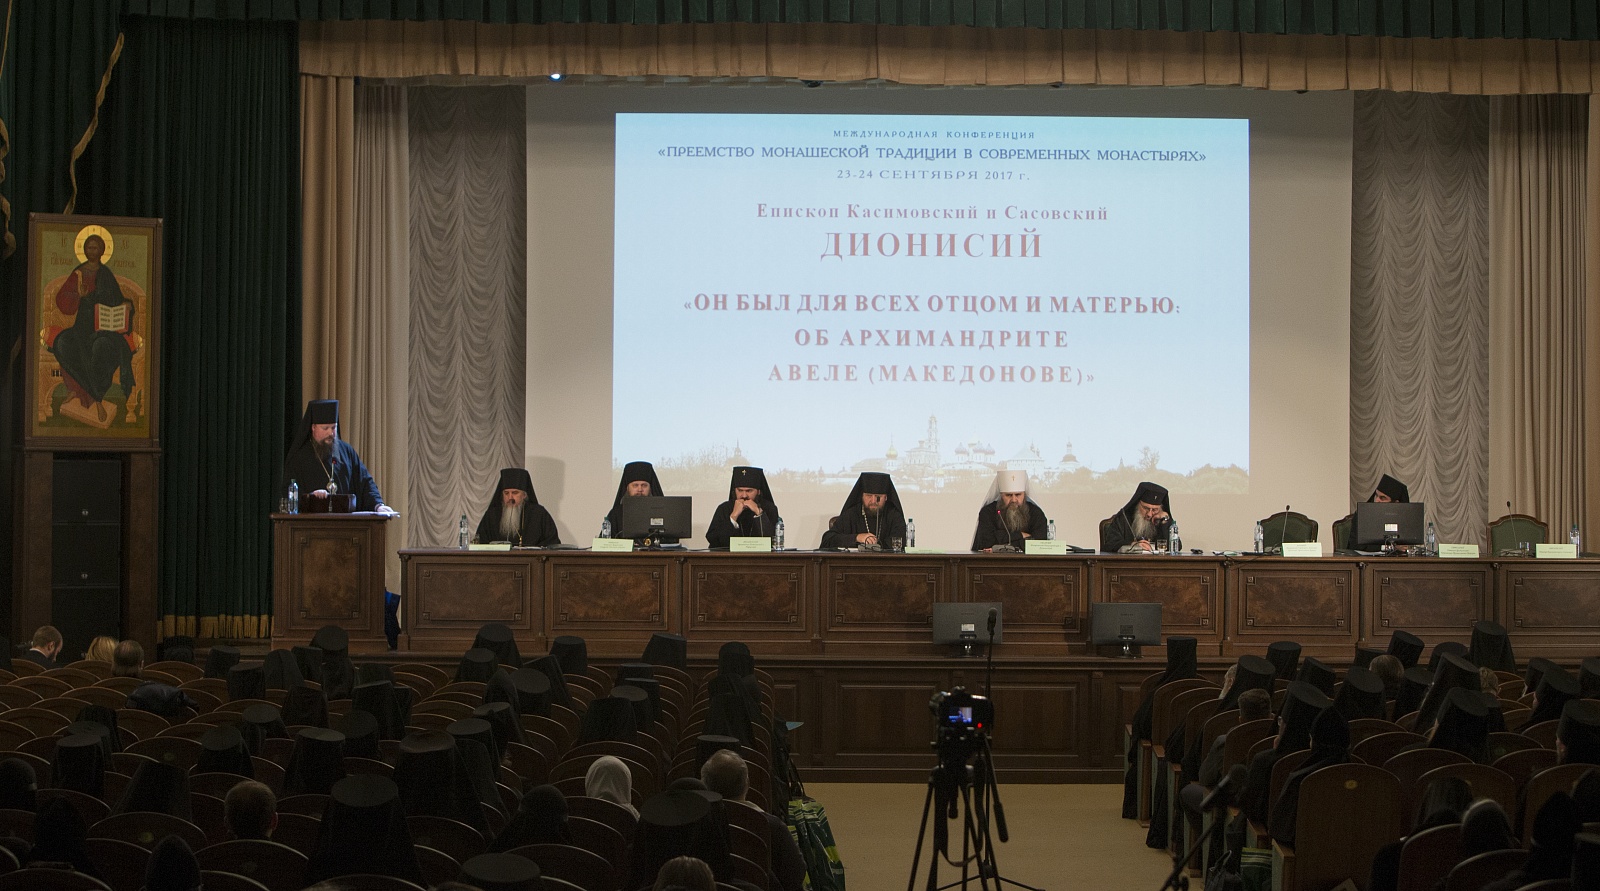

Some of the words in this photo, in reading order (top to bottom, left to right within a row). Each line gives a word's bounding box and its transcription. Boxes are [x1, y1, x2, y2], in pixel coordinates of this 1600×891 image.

[833, 129, 938, 139] МЕЖДУНАРОДНАЯ
[946, 130, 1036, 141] КОНФЕРЕНЦИЯ
[657, 145, 755, 158] «ПРЕЕМСТВО
[761, 144, 870, 159] МОНАШЕСКОЙ
[875, 147, 957, 162] ТРАДИЦИИ
[963, 148, 973, 160] В
[978, 148, 1091, 161] СОВРЕМЕННЫХ
[1096, 149, 1207, 162] МОНАСТЫРЯХ»
[836, 169, 873, 179] 23-24
[879, 169, 978, 180] СЕНТЯБРЯ
[984, 170, 1013, 180] 2017
[756, 203, 839, 219] Епископ
[846, 203, 978, 219] Касимовский
[986, 208, 996, 220] и
[1004, 204, 1108, 221] Сасовский
[820, 227, 1042, 262] ДИОНИСИЙ
[683, 292, 728, 311] «ОН
[735, 293, 791, 312] БЫЛ
[796, 294, 848, 315] ДЛЯ
[854, 294, 921, 313] ВСЕХ
[927, 294, 1018, 317] ОТЦОМ
[1025, 295, 1042, 313] И
[794, 328, 829, 347] ОБ
[839, 329, 1068, 351] АРХИМАНДРИТЕ
[767, 363, 858, 382] АВЕЛЕ
[868, 364, 1095, 386] (МАКЕДОНОВЕ)»
